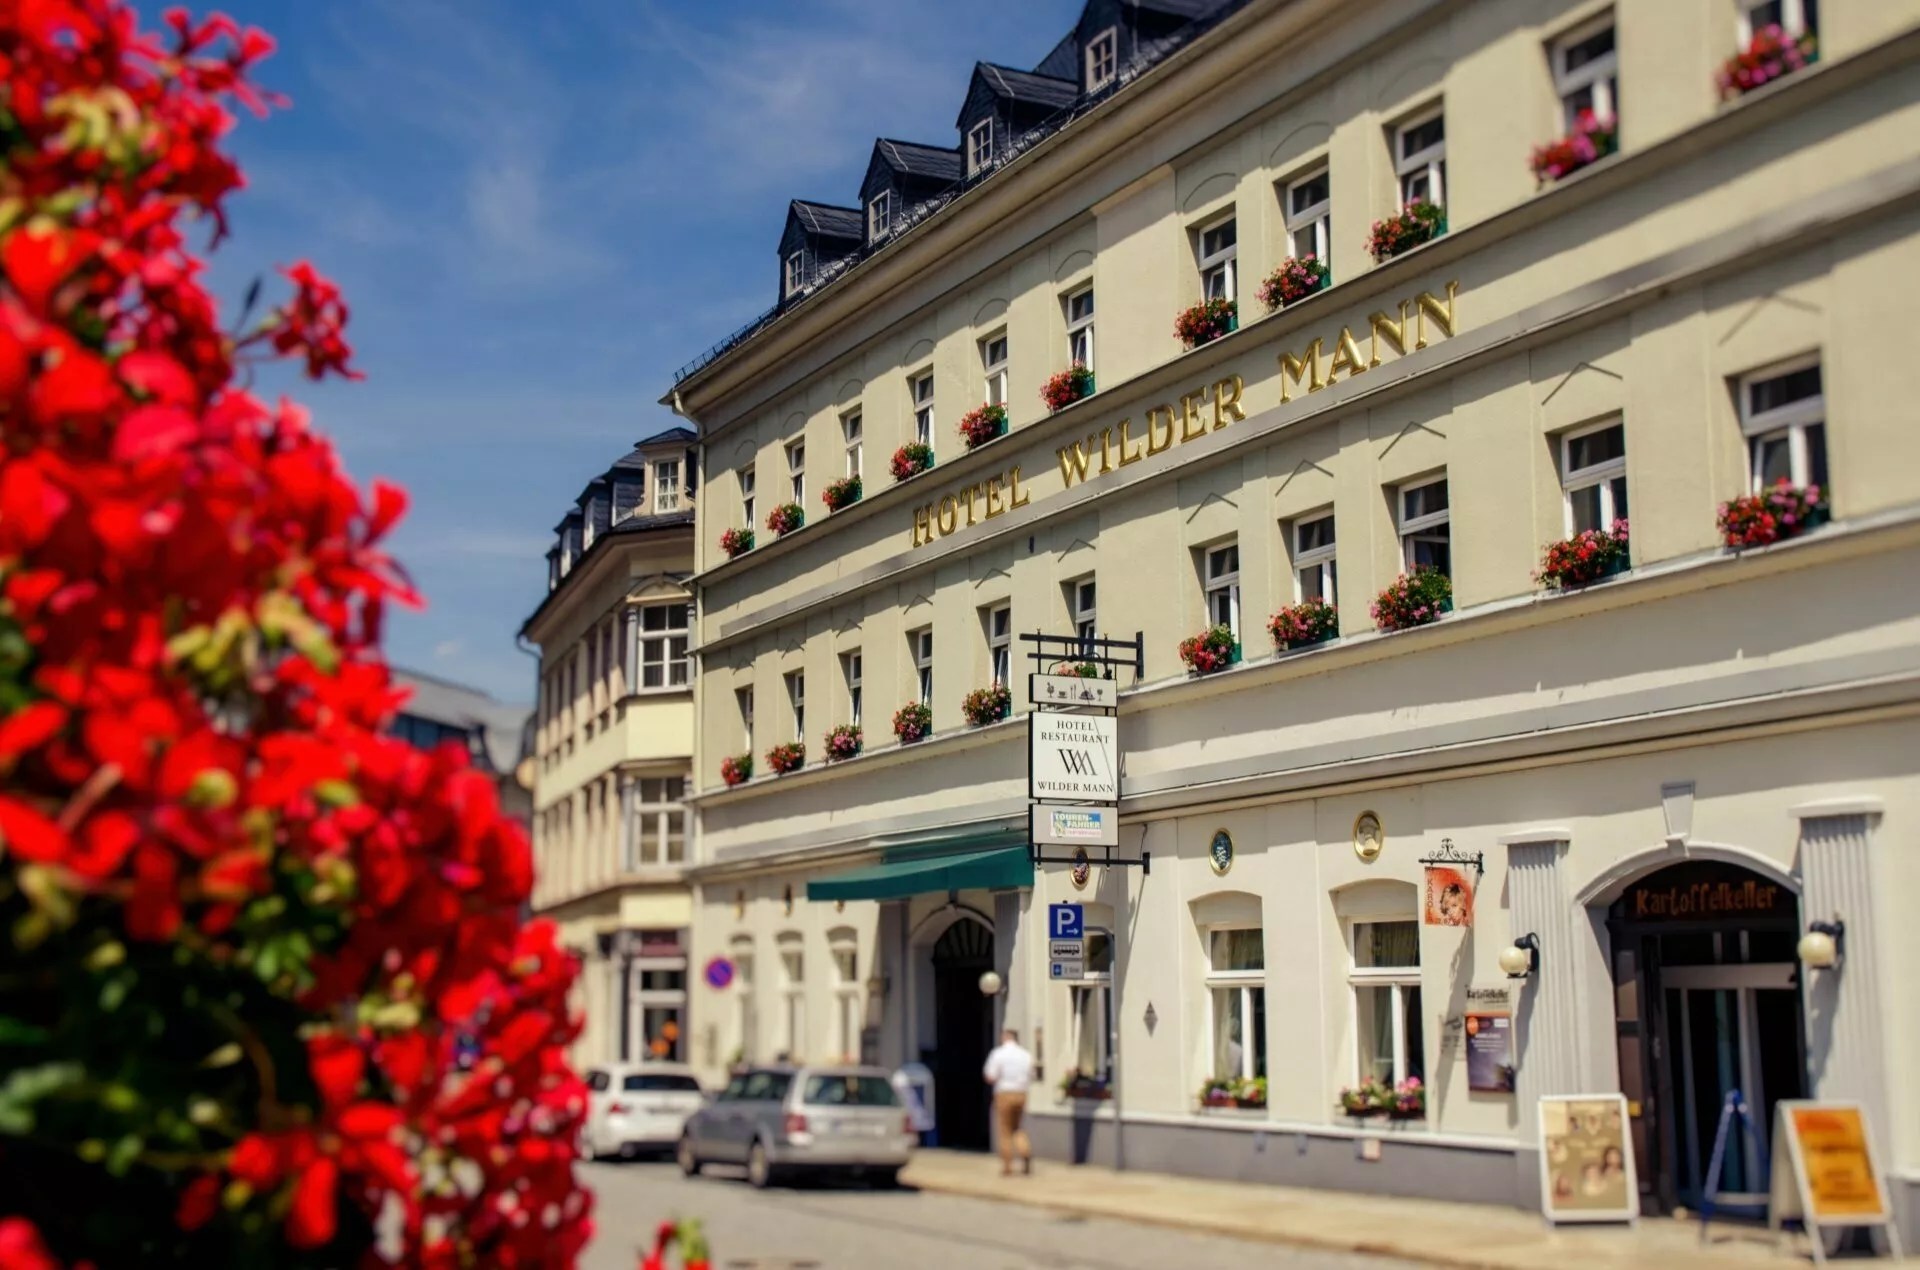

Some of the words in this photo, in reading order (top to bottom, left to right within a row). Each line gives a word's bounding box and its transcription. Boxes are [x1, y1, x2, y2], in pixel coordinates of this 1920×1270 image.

[912, 465, 1030, 547] HOTEL
[1056, 373, 1247, 488] WILDER
[1278, 279, 1460, 403] MANN
[1057, 720, 1095, 732] HOTEL
[1041, 731, 1110, 744] RESTAURANT
[1037, 780, 1080, 792] WILDER
[1082, 783, 1113, 793] MANN
[1636, 880, 1777, 915] Kartoffelkeller
[1056, 908, 1076, 936] P
